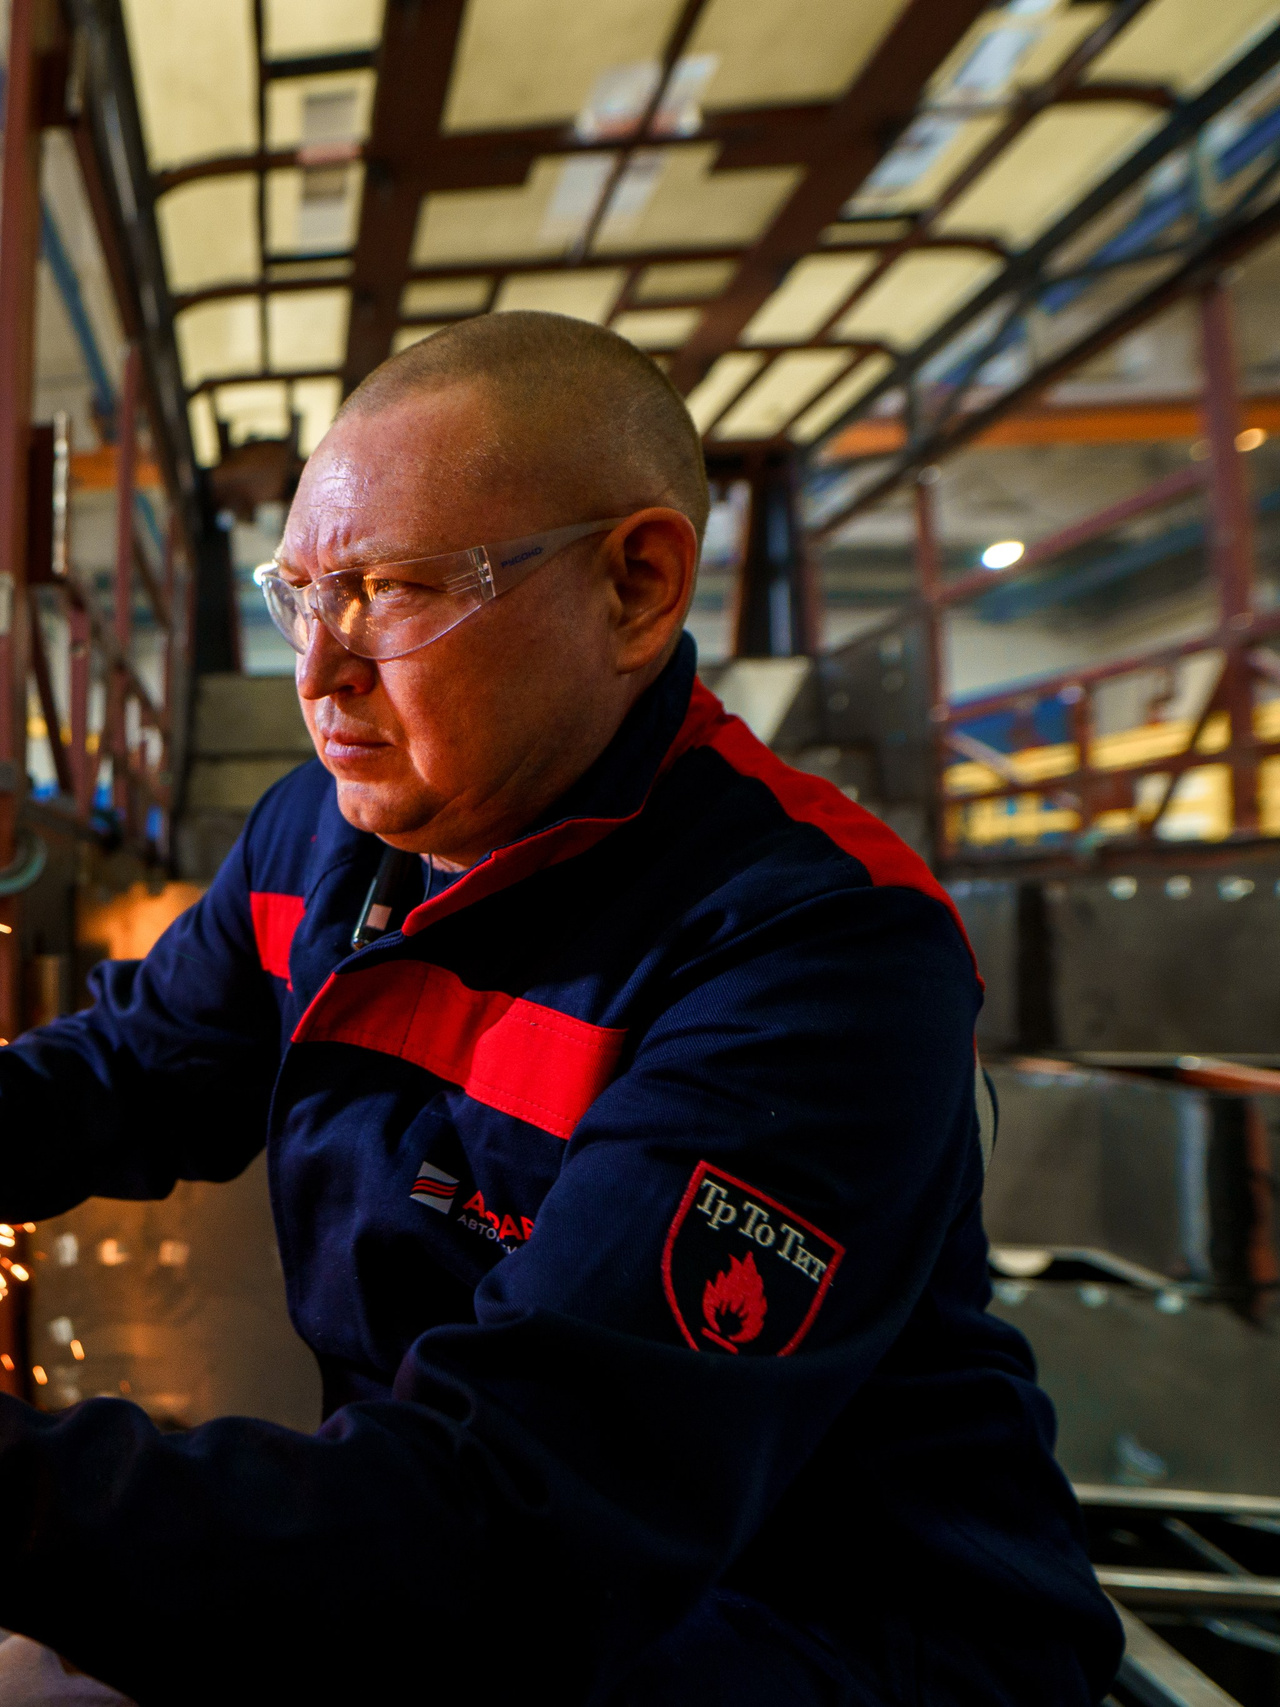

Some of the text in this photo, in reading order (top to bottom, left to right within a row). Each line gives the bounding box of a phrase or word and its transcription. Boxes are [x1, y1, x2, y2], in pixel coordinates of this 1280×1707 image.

[696, 1178, 828, 1283] Тр То Тит
